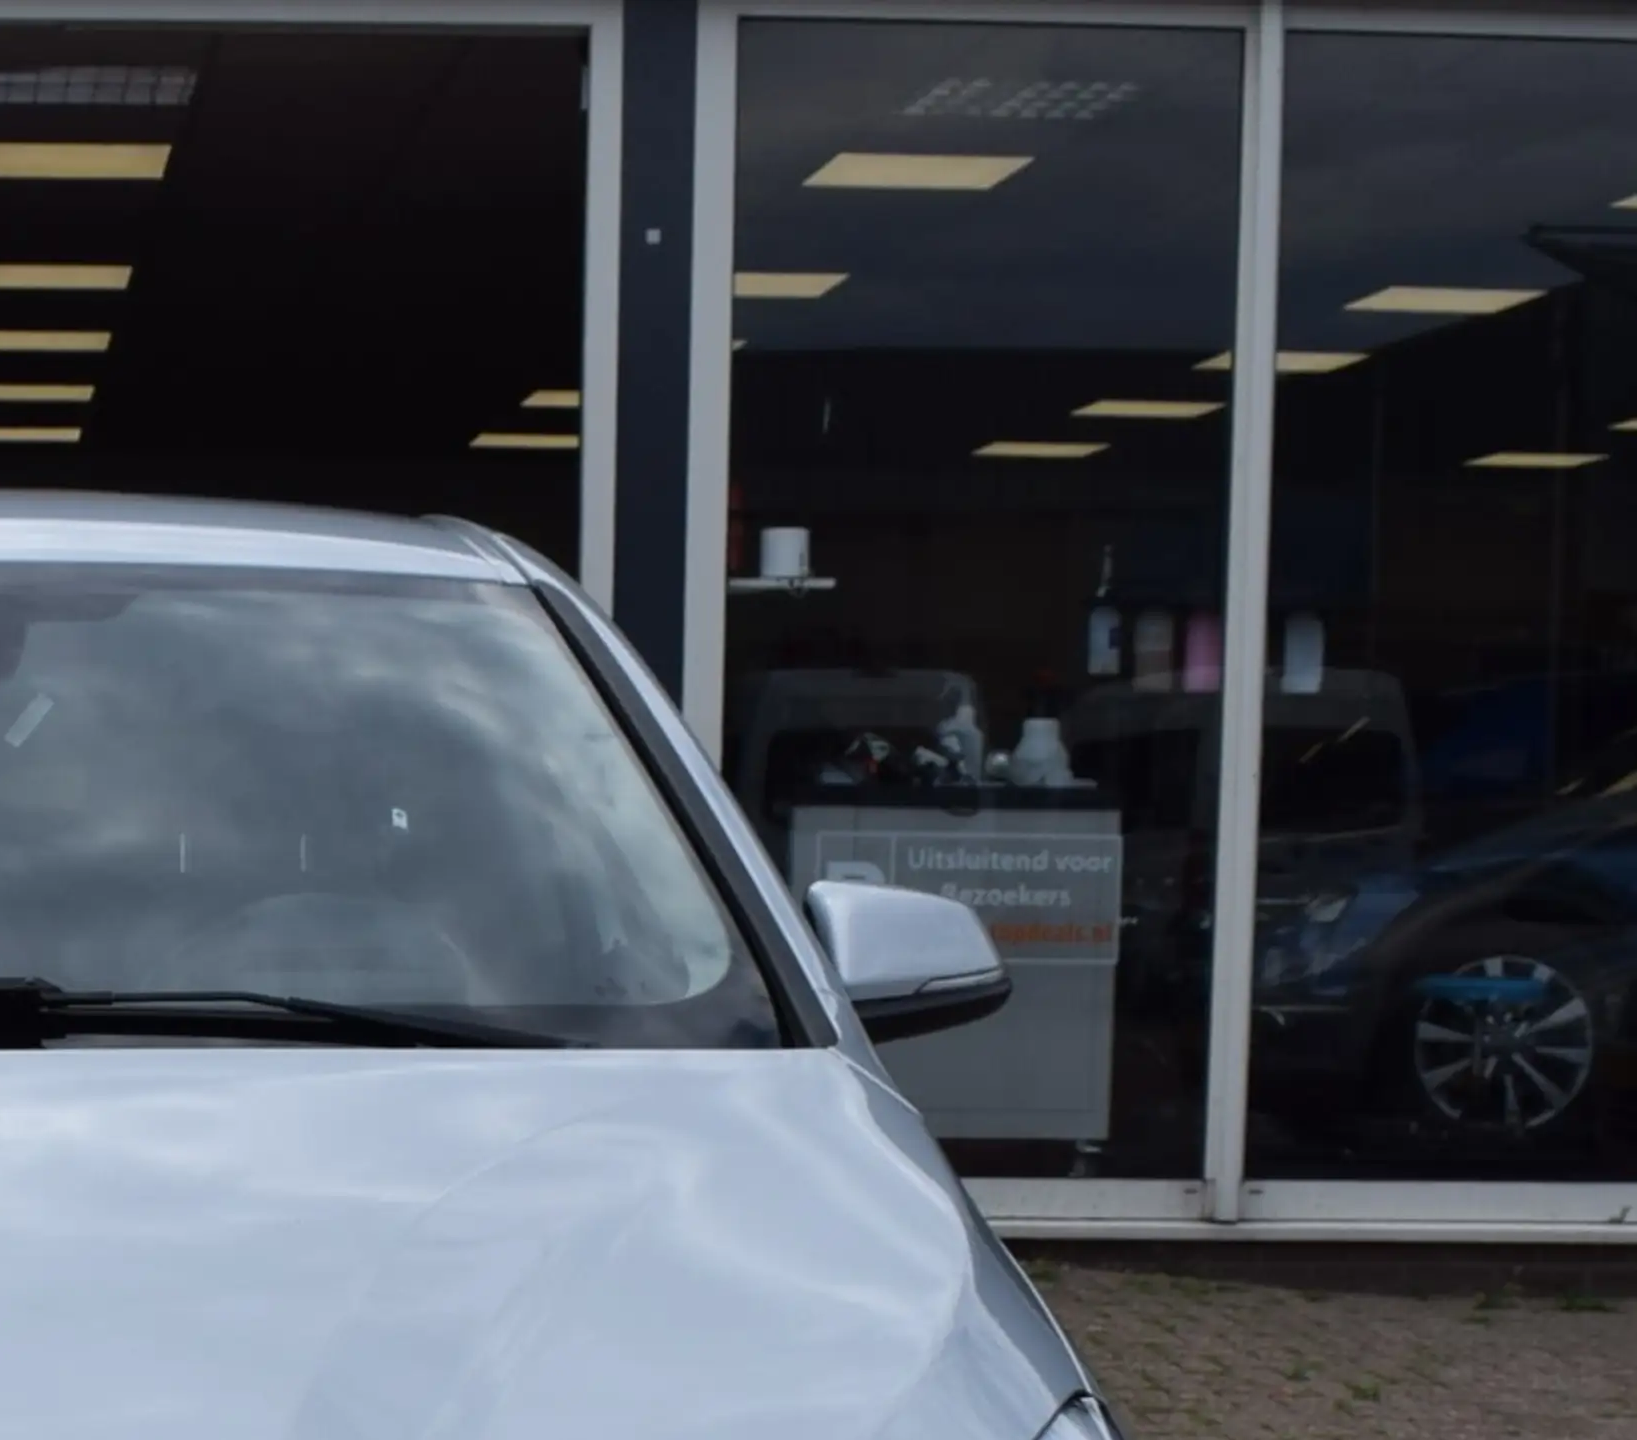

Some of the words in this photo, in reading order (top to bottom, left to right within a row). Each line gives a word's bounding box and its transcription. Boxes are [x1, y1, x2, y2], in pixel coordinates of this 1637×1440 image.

[906, 845, 1049, 872] Uitsluitend
[1055, 852, 1113, 873] voor
[940, 882, 1072, 907] Bezoekers
